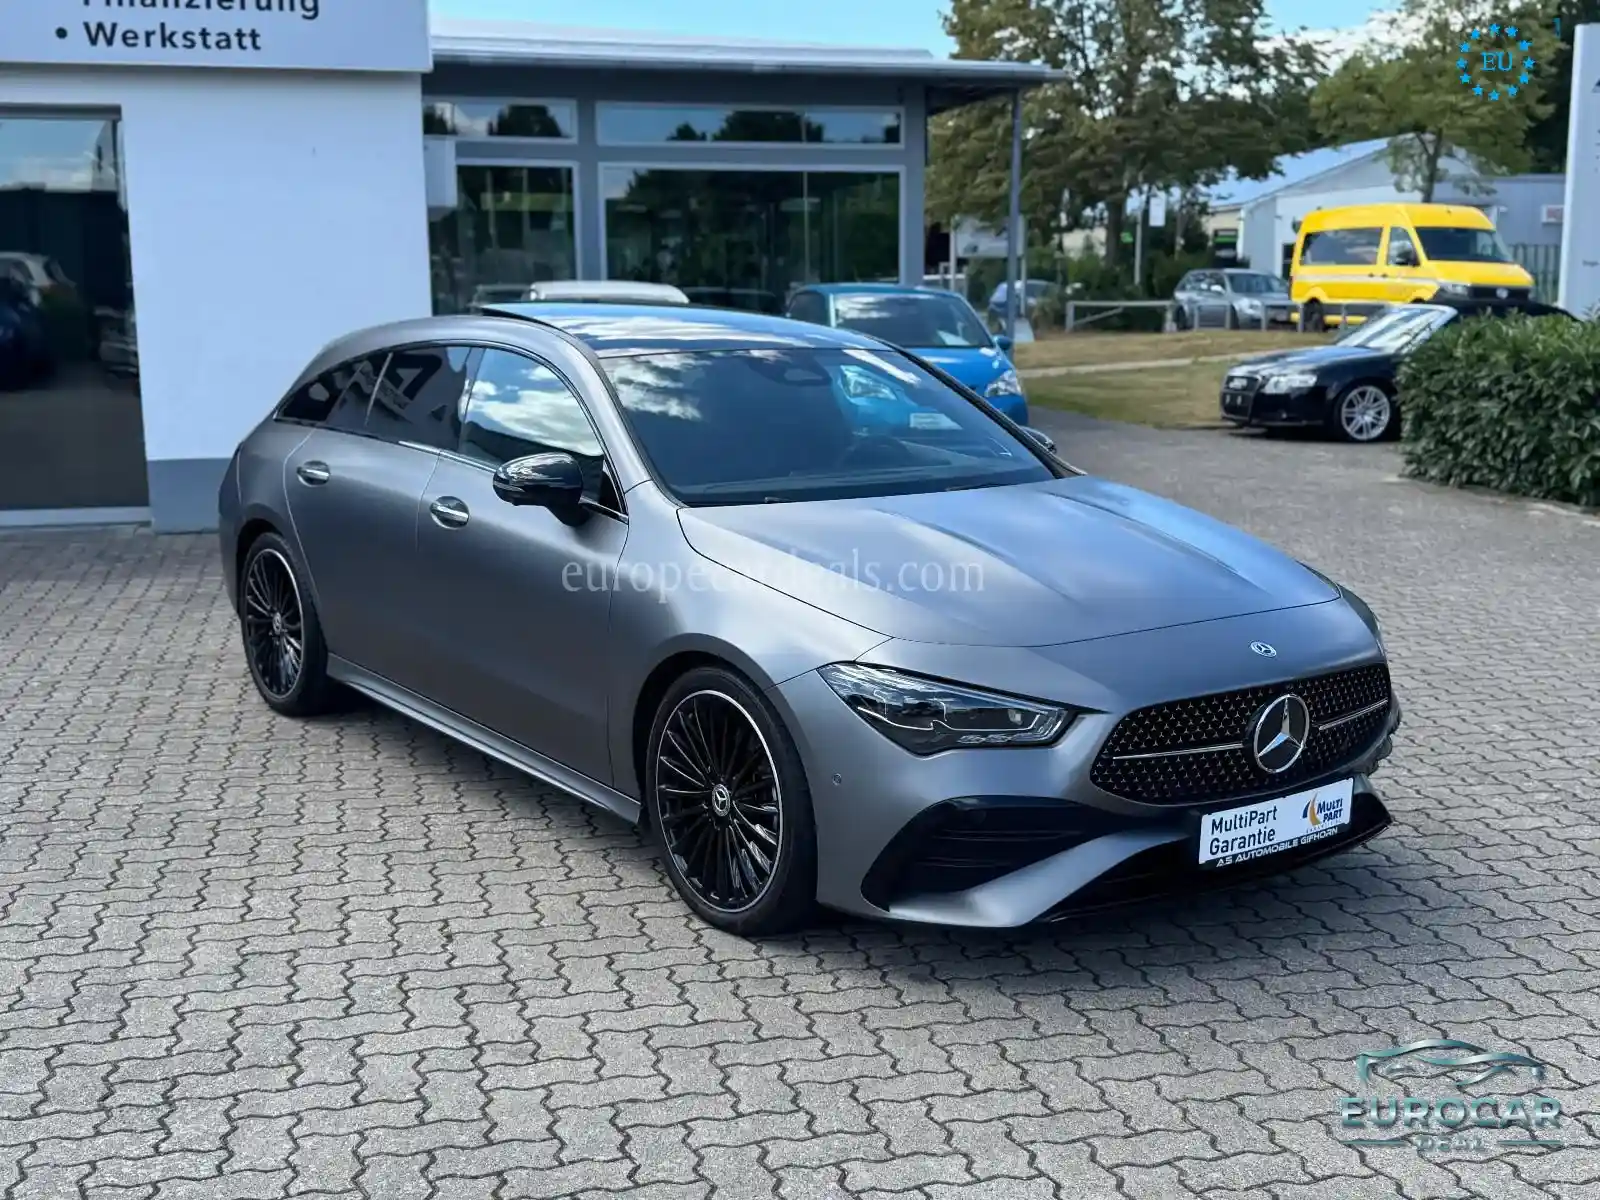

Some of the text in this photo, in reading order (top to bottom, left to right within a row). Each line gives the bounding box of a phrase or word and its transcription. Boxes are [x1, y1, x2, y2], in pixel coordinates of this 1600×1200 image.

[83, 0, 319, 20] zerung
[83, 21, 261, 50] Werkstatt
[1211, 805, 1278, 835] MultiPart
[1316, 798, 1343, 815] MULTI
[1323, 808, 1343, 822] PART
[1209, 826, 1276, 855] Garantie
[1235, 837, 1298, 863] AUTOMOBILE
[1300, 826, 1338, 845] GIFHORN
